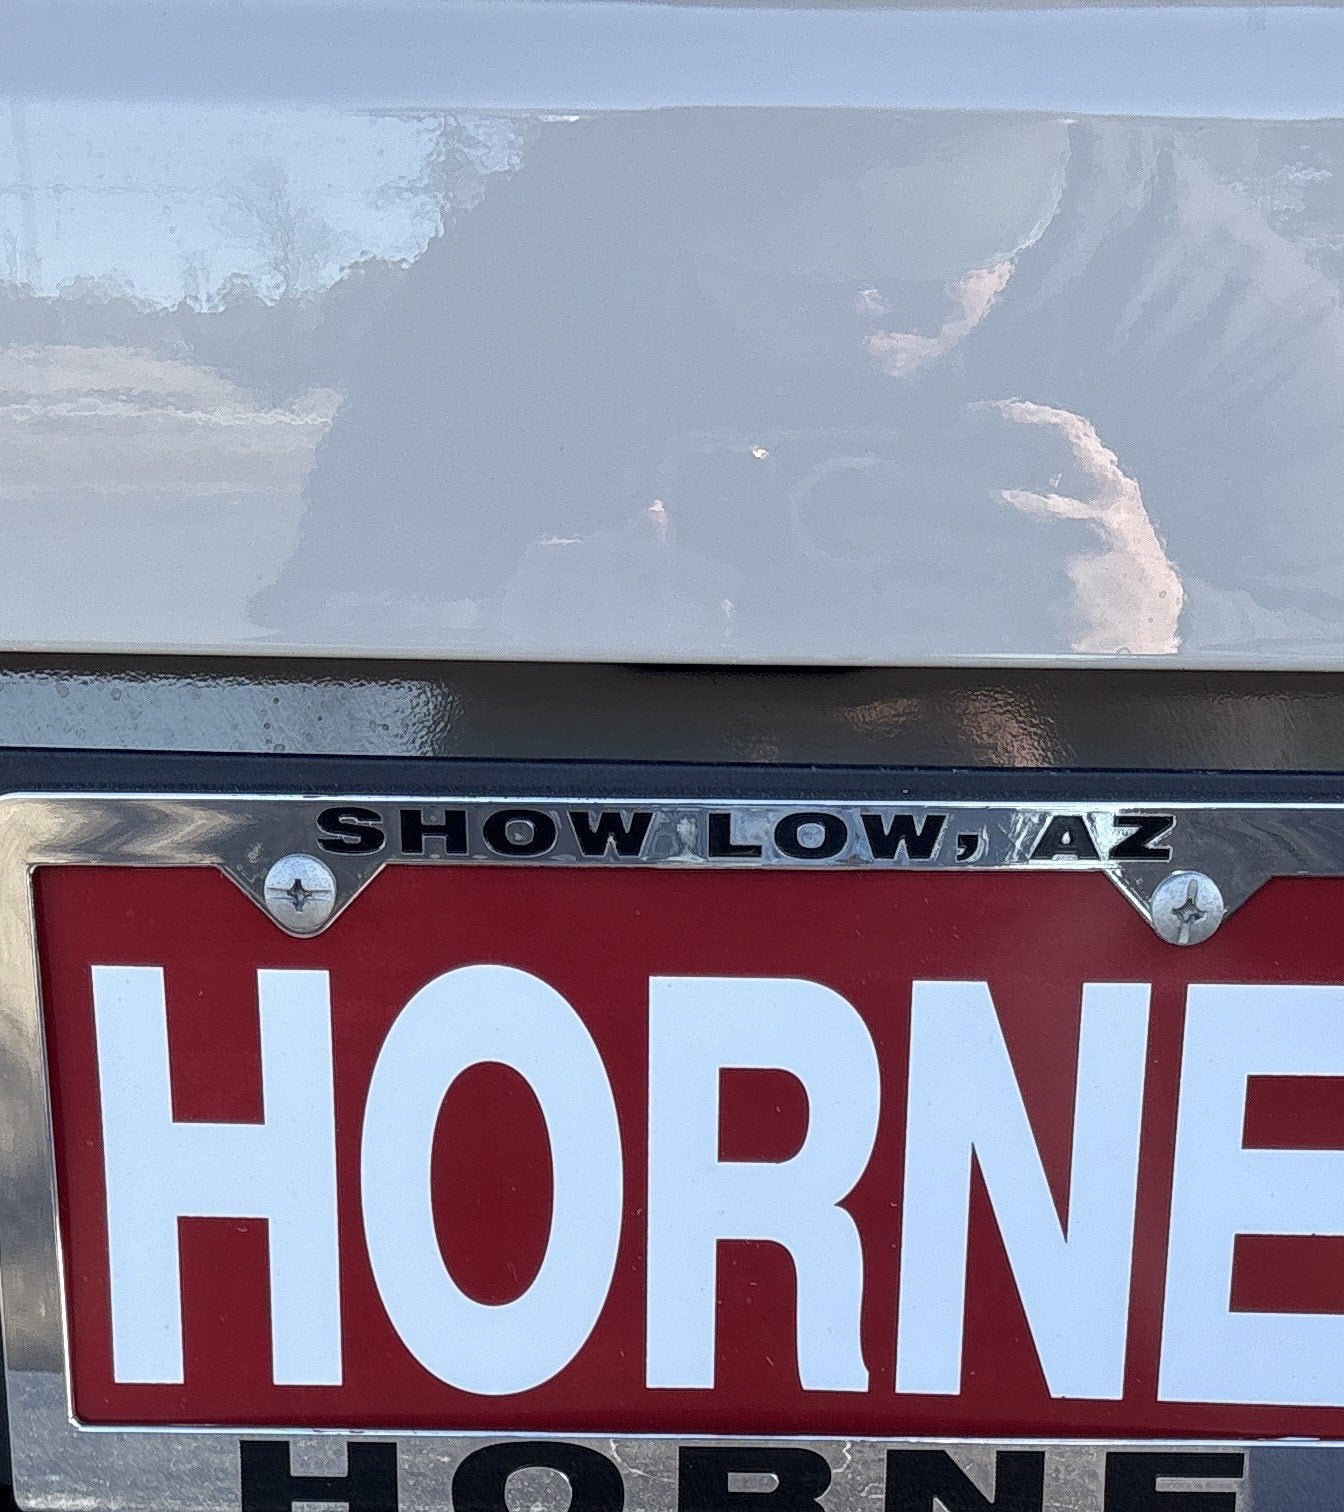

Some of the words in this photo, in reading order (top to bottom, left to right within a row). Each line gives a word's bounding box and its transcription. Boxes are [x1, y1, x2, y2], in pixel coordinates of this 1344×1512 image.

[317, 806, 655, 858] SHOW
[707, 811, 980, 862] LOW,
[1029, 813, 1177, 863] AZ
